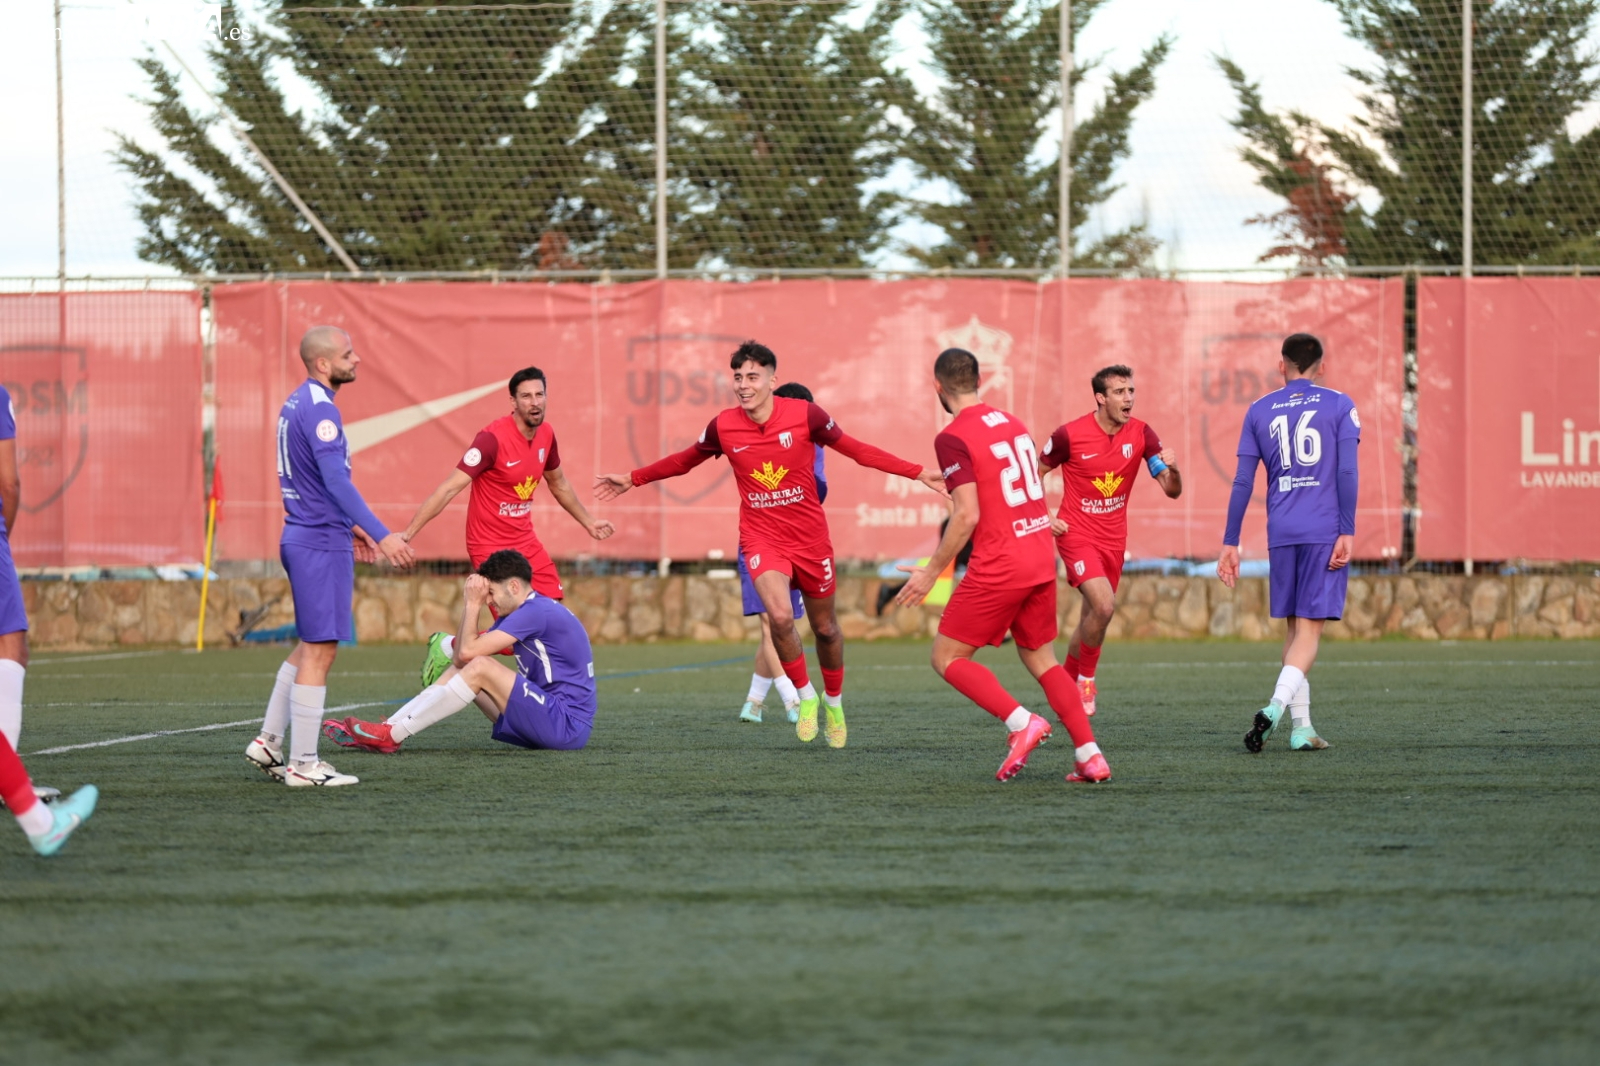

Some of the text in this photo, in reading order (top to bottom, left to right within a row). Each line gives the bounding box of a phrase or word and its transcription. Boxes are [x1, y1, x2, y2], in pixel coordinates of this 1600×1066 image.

[1269, 410, 1322, 470] 16
[989, 432, 1044, 508] 20
[748, 485, 804, 502] CAJA RURAL
[857, 502, 918, 527] Santa
[821, 557, 833, 581] 3
